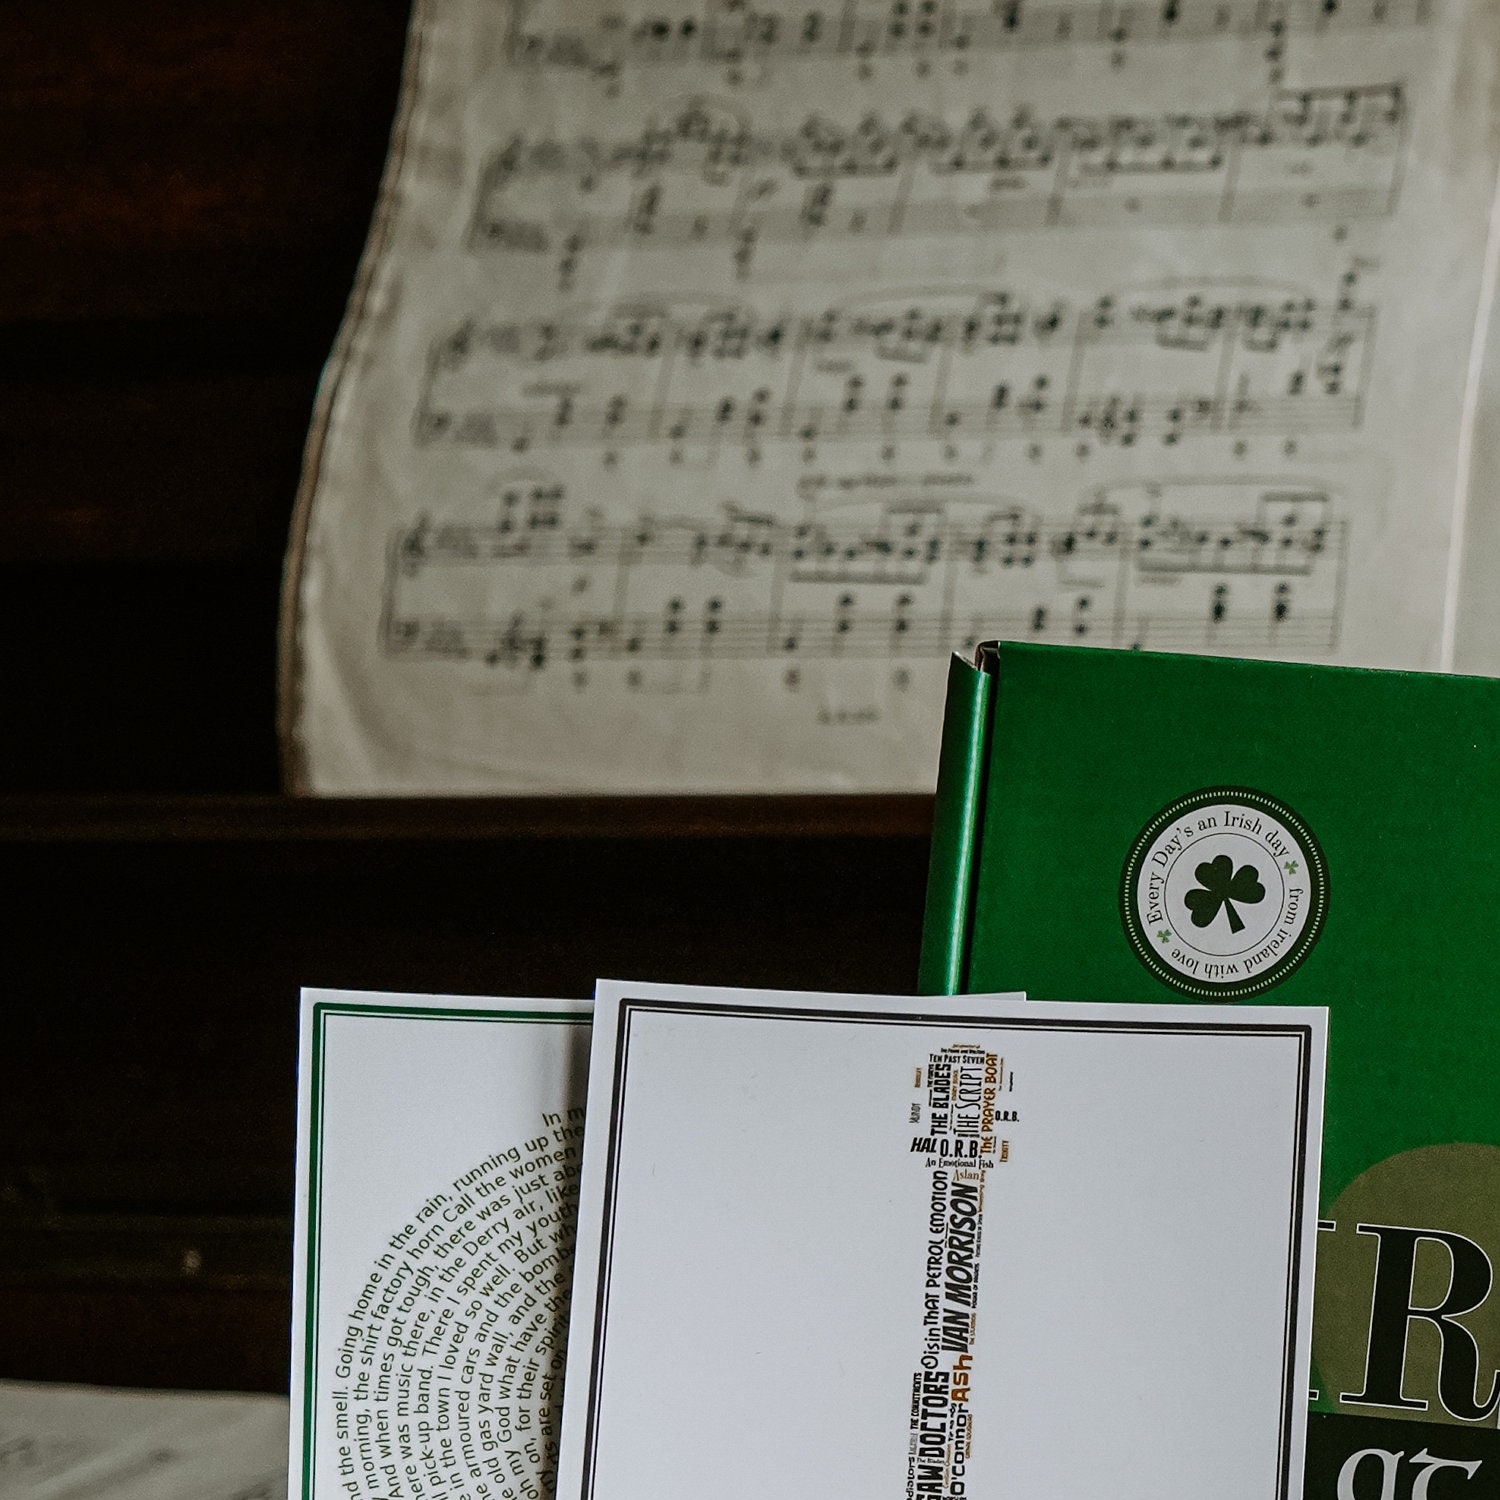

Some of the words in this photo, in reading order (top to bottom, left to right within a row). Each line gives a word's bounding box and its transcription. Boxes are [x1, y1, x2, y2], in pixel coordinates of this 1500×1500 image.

[1198, 817, 1217, 831] an
[1224, 811, 1262, 835] Irish
[1151, 828, 1193, 868] Day's
[1265, 830, 1290, 859] day
[1146, 873, 1164, 925] Every
[1284, 888, 1304, 925] from
[1171, 948, 1200, 975] love
[1244, 929, 1293, 974] ireland
[1204, 962, 1239, 979] with
[933, 1064, 952, 1108] BLADES
[955, 1067, 982, 1110] SCRIPT
[553, 1125, 585, 1142] the
[931, 1113, 948, 1136] THE
[954, 1114, 980, 1138] THE
[509, 1141, 579, 1179] women
[524, 1136, 549, 1152] up
[940, 1139, 982, 1157] O.R.B.
[452, 1146, 521, 1196] running
[474, 1176, 507, 1197] the
[511, 1174, 549, 1203] just
[415, 1194, 453, 1223] rain,
[442, 1193, 475, 1222] Call
[475, 1194, 511, 1221] was
[388, 1224, 417, 1250] the
[406, 1224, 444, 1260] horn
[432, 1220, 476, 1259] there
[944, 1182, 978, 1307] MORRISON
[373, 1253, 395, 1270] in
[348, 1272, 382, 1321] home
[370, 1260, 414, 1320] factory
[396, 1265, 439, 1313] tough,
[359, 1323, 382, 1366] shirt
[386, 1316, 407, 1347] got
[941, 1308, 970, 1352] VAN
[335, 1325, 363, 1378] Going
[352, 1371, 370, 1401] the
[373, 1352, 395, 1402] times
[951, 1354, 973, 1402] Ash
[331, 1386, 349, 1439] smell.
[919, 1371, 950, 1458] DOCTORS
[353, 1408, 380, 1490] morning,
[374, 1409, 392, 1459] when
[950, 1403, 969, 1496] O'Connor
[337, 1446, 354, 1476] the
[379, 1463, 404, 1498] And
